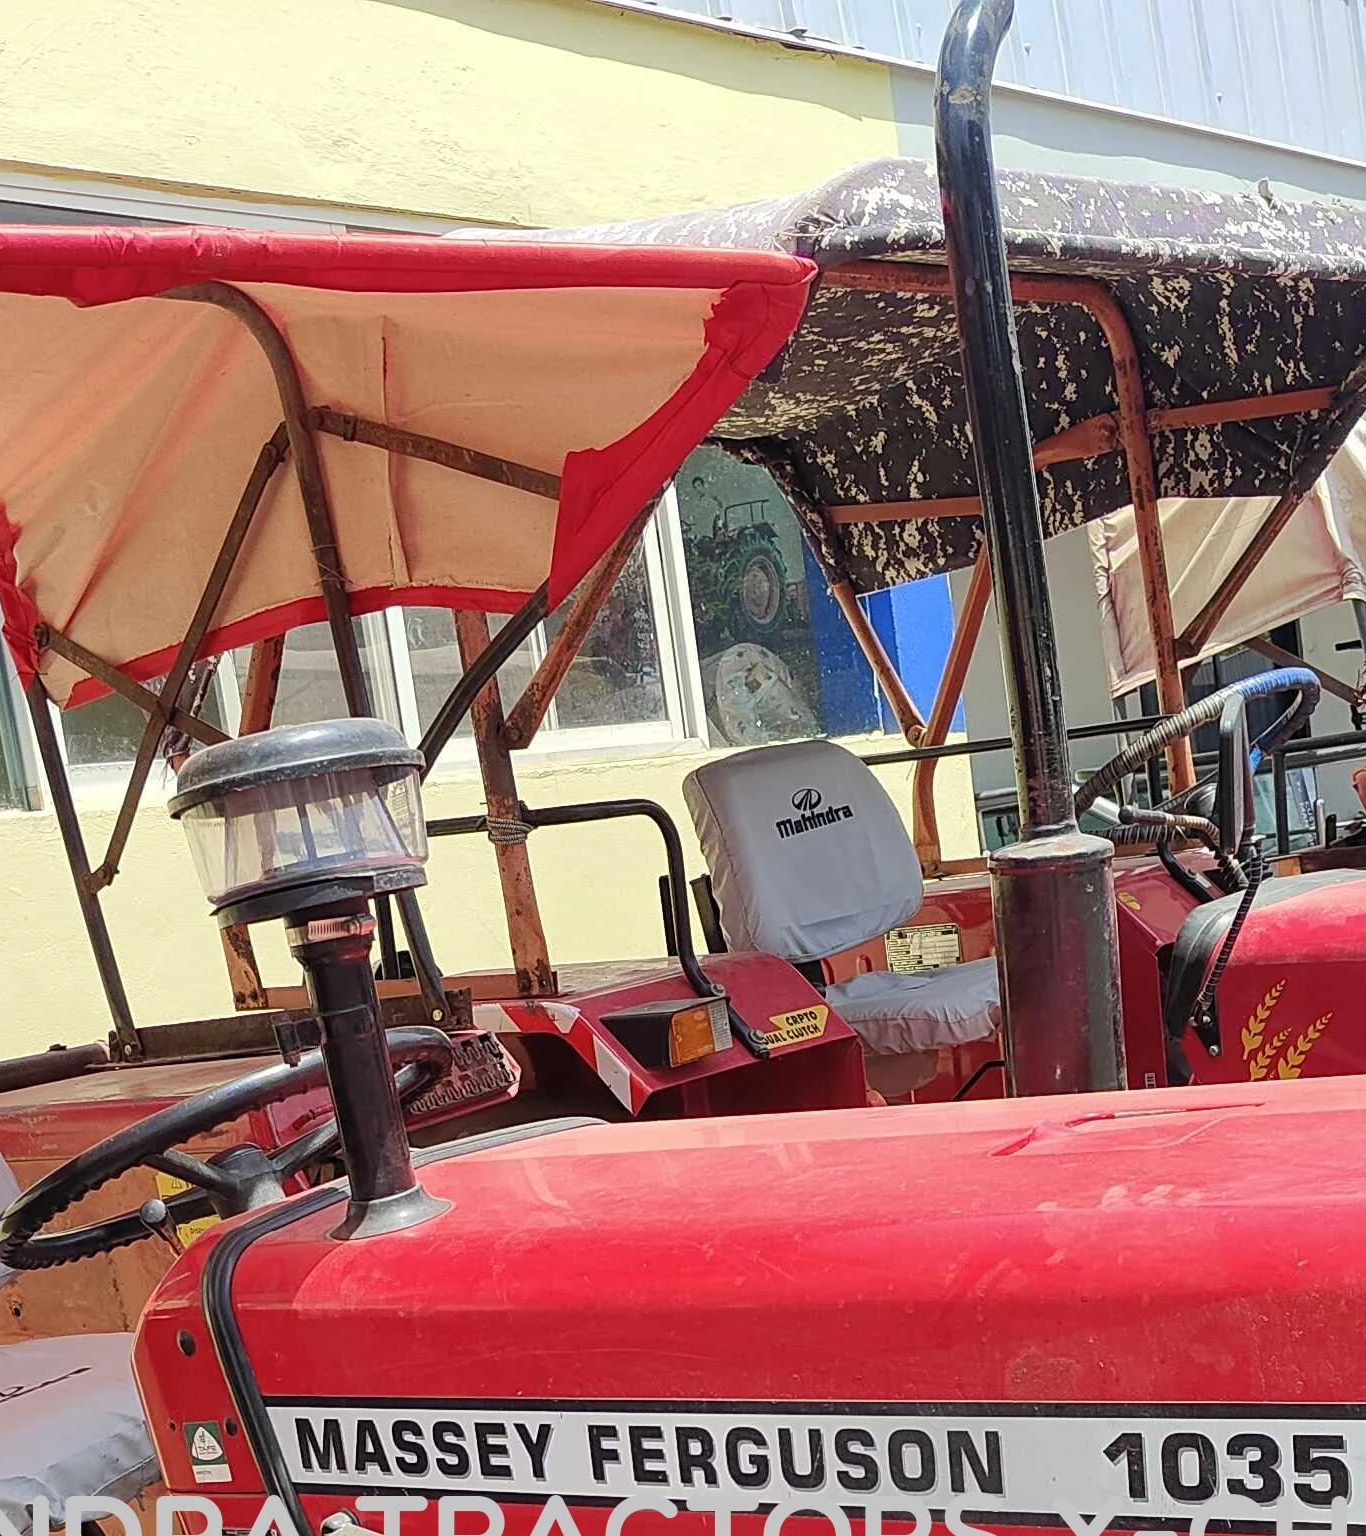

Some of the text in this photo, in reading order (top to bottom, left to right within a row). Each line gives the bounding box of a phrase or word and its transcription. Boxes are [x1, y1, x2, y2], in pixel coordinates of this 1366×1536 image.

[775, 805, 853, 839] Mahindra
[786, 1023, 821, 1040] CLUTCH
[294, 1417, 555, 1482] MASSEY
[588, 1425, 1006, 1497] FERGUSON
[1102, 1432, 1353, 1509] 1035
